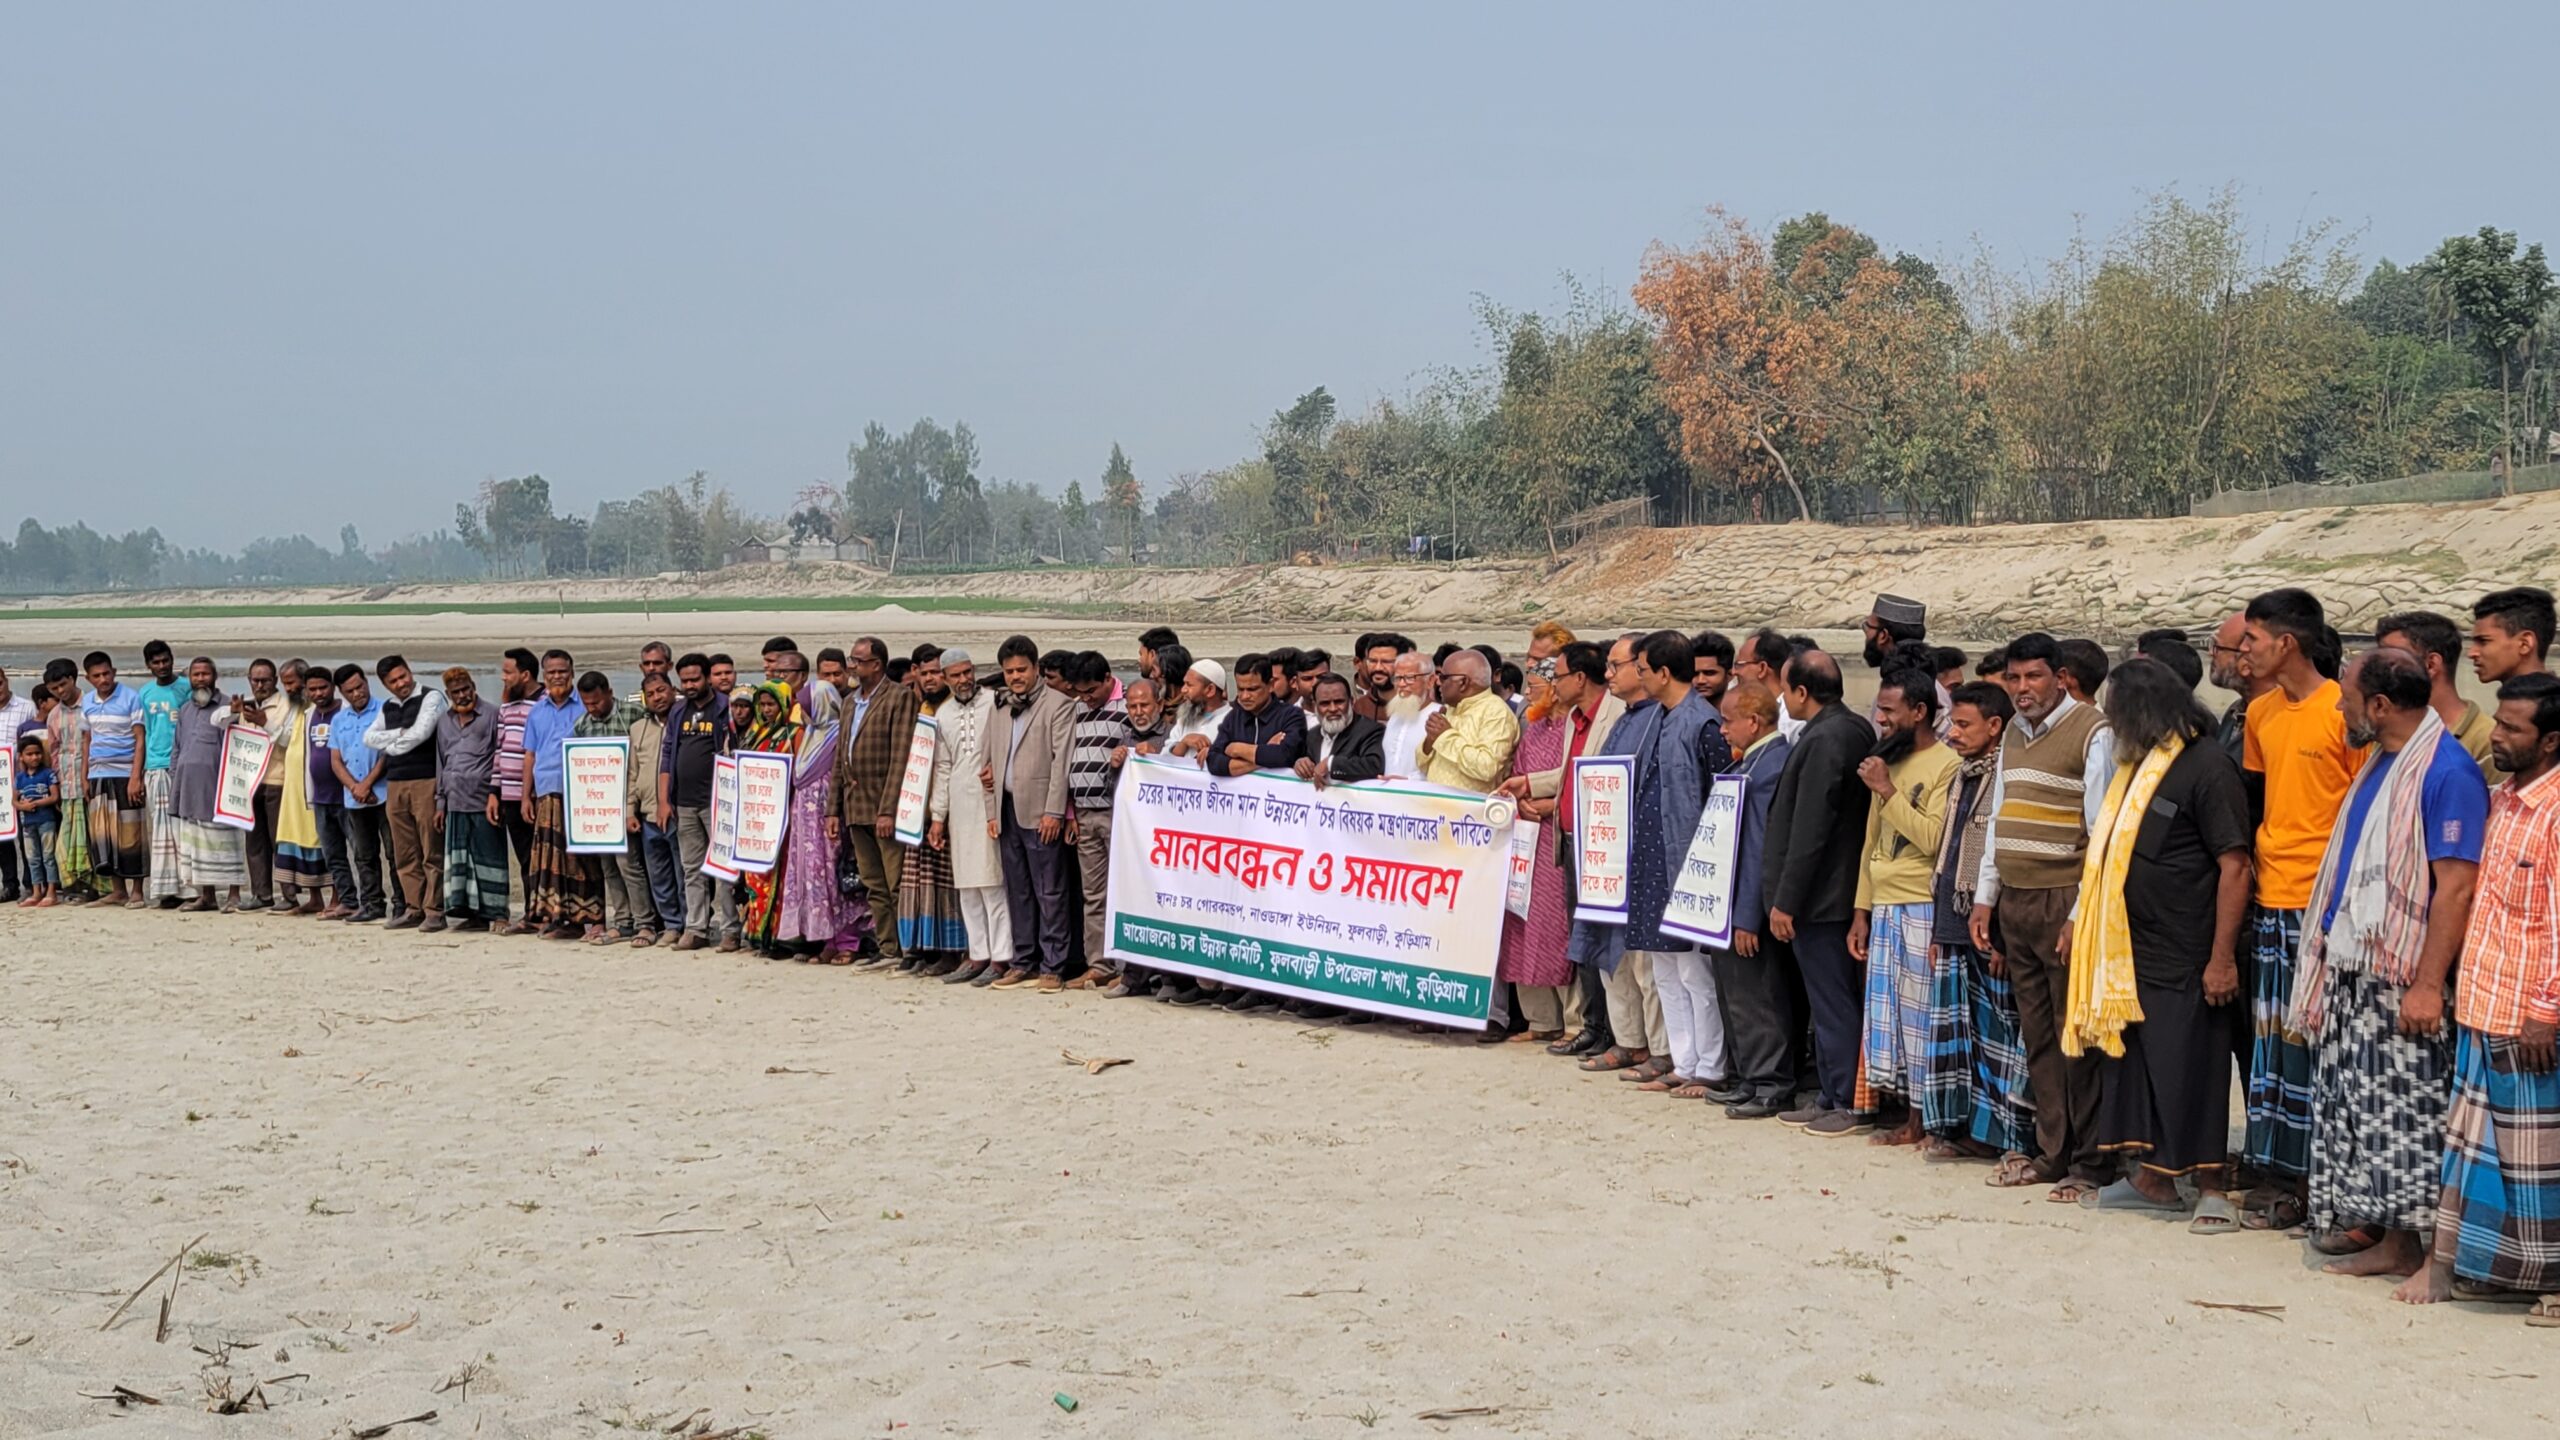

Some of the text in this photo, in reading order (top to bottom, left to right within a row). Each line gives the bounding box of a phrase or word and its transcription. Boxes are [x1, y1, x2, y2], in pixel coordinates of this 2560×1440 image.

[1138, 782, 1164, 806] চরের
[1167, 785, 1202, 816] মানুষের
[1206, 782, 1234, 815] জীবন
[1238, 792, 1260, 819] মান
[1264, 790, 1310, 826] উন্নয়নে
[1339, 802, 1374, 835] বিষয়ক
[1450, 814, 1493, 846] দাবিতে
[1150, 828, 1464, 910] মানববন্ধন ও সমাবেশ
[1688, 852, 1717, 880] বিষয়ক
[1180, 896, 1192, 910] চর
[1250, 907, 1293, 928] নাওডাঙ্গা
[1297, 912, 1342, 939] ইউনিয়ন,
[1348, 923, 1390, 946] ফুলবাড়ী,
[1394, 928, 1432, 950] কুড়িগ্রাম
[1179, 933, 1195, 954] চর
[1200, 931, 1228, 960] উন্নয়ন
[1229, 939, 1264, 972] কমিটি,
[1270, 949, 1320, 980] ফুলবাড়ী
[1324, 956, 1377, 988] উপজেলা
[1380, 970, 1410, 998] শাখা,
[1416, 972, 1468, 1004] কুড়িগ্রাম
